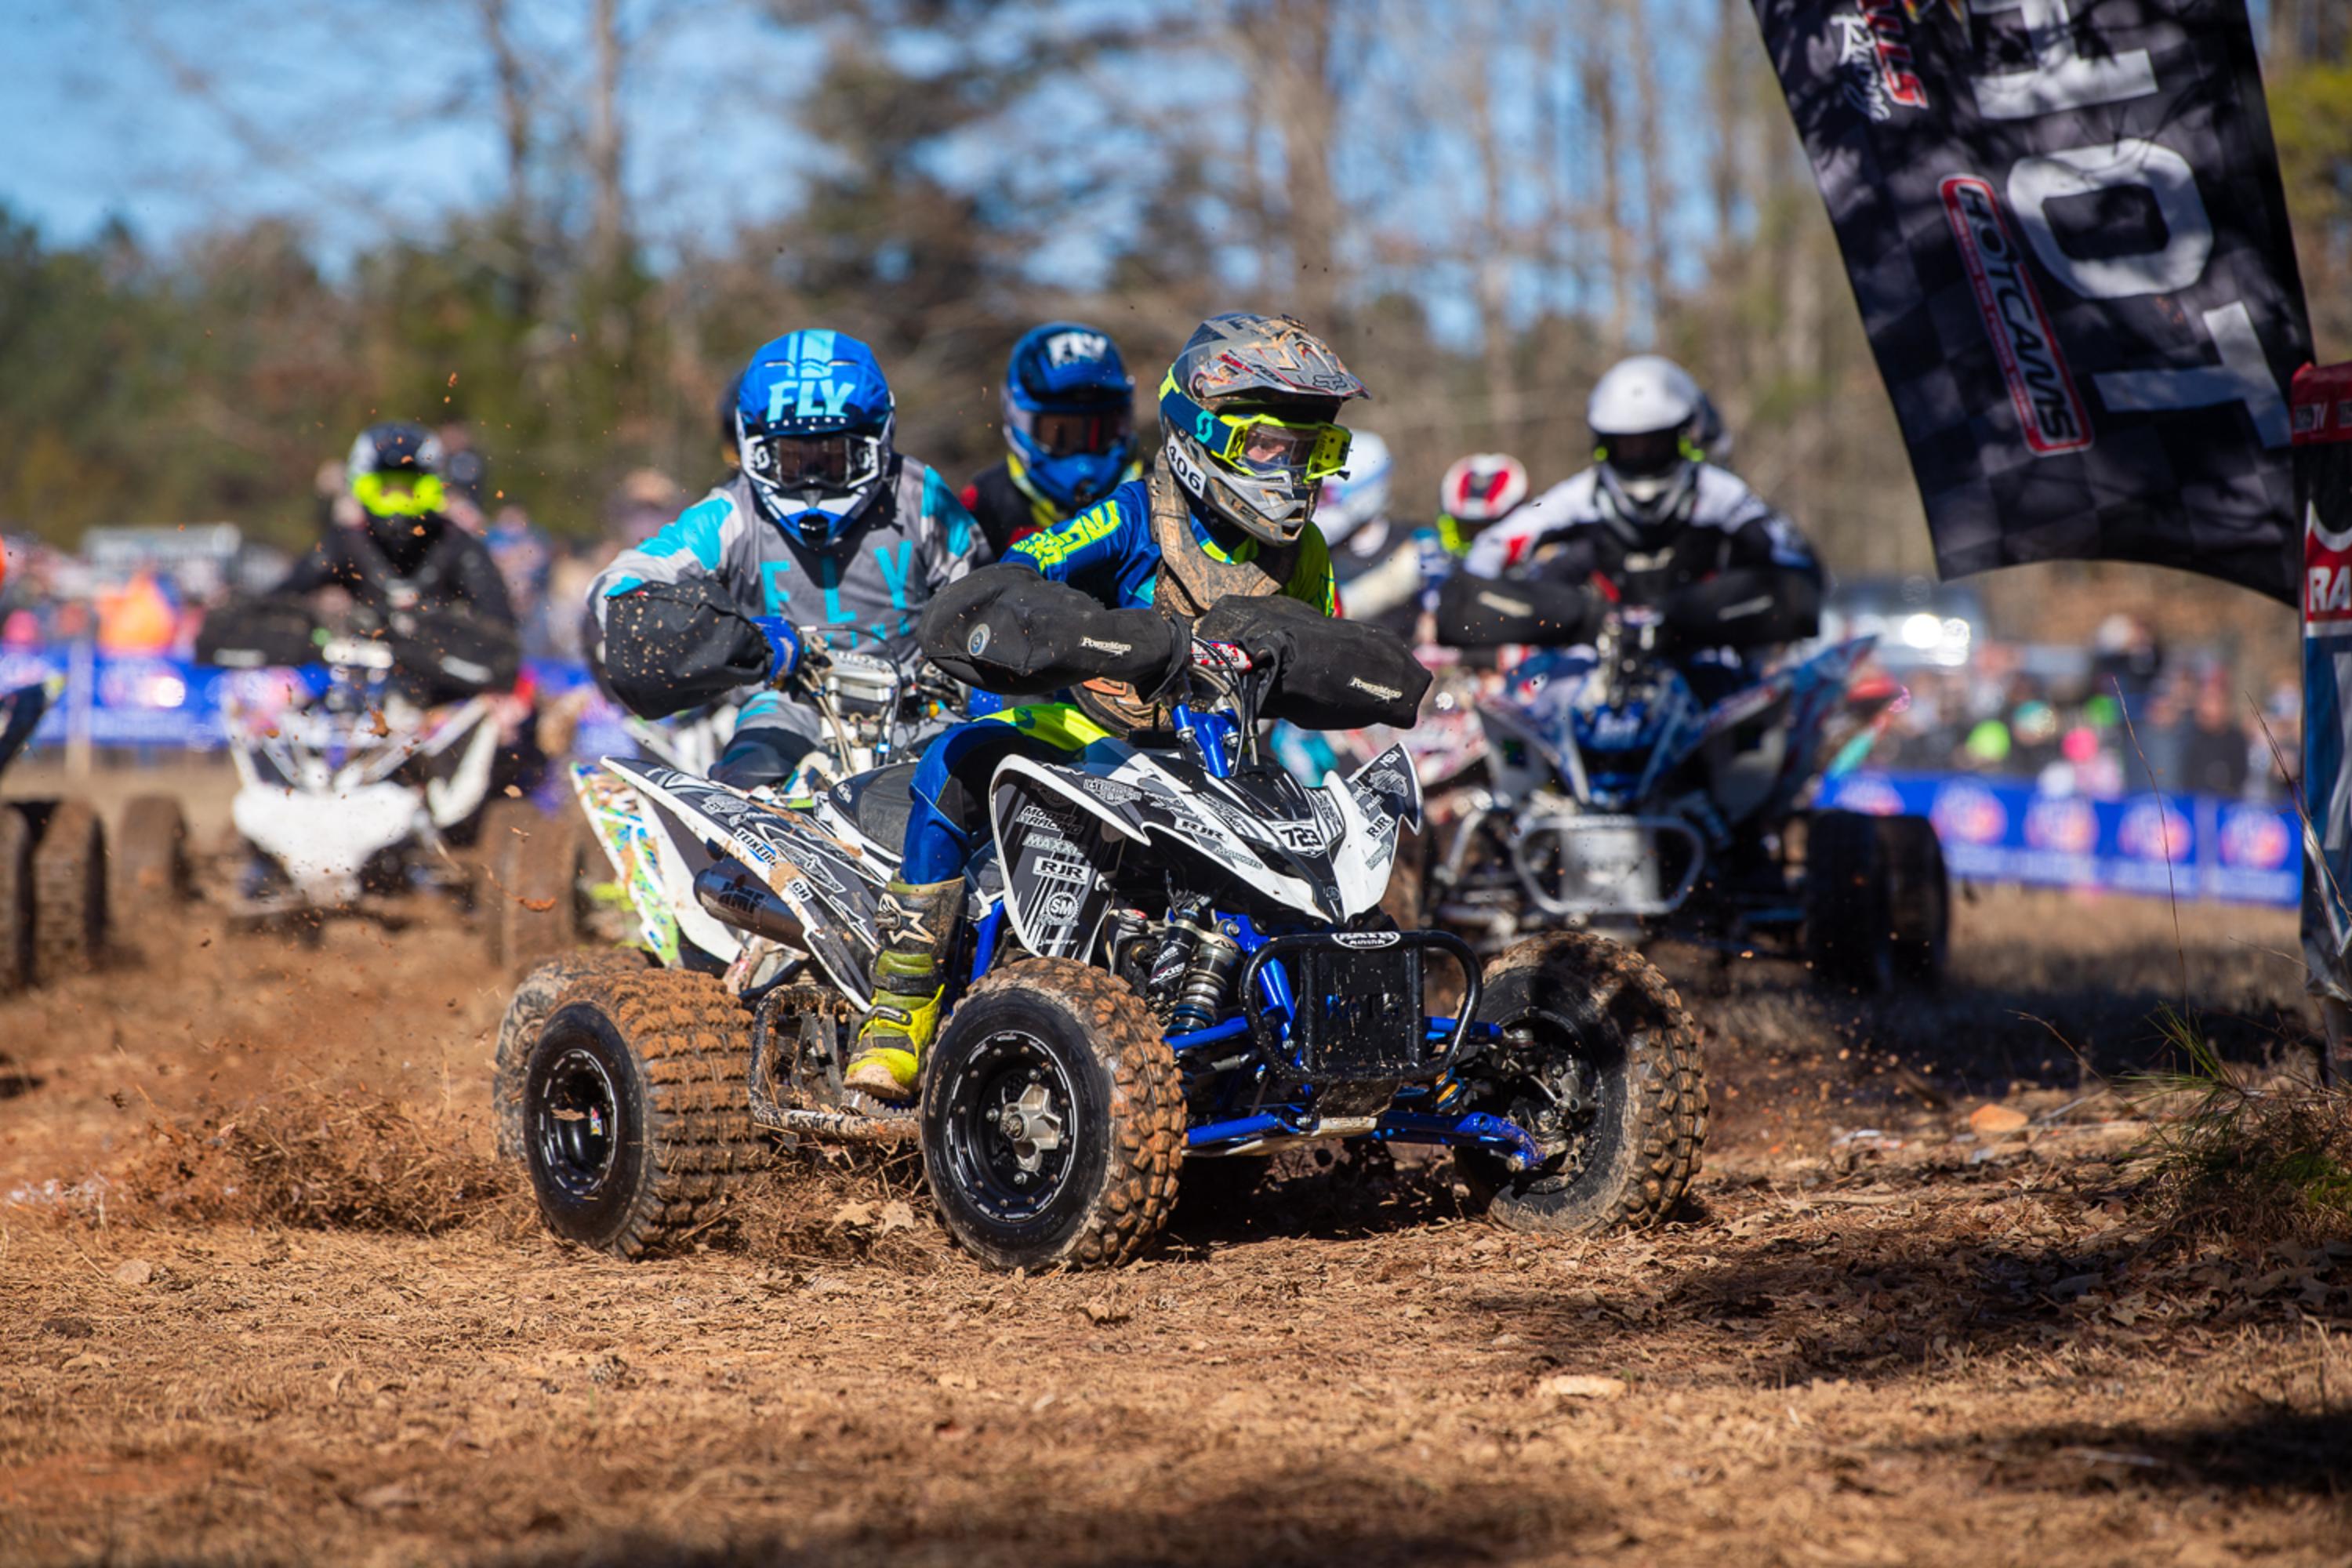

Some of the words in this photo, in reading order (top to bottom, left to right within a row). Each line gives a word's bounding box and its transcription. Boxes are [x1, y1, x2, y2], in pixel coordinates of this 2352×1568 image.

[766, 378, 856, 423] FLY
[760, 536, 913, 624] FLY
[1367, 816, 1390, 838] RJR
[1040, 859, 1083, 880] RJR
[1050, 899, 1074, 917] SM
